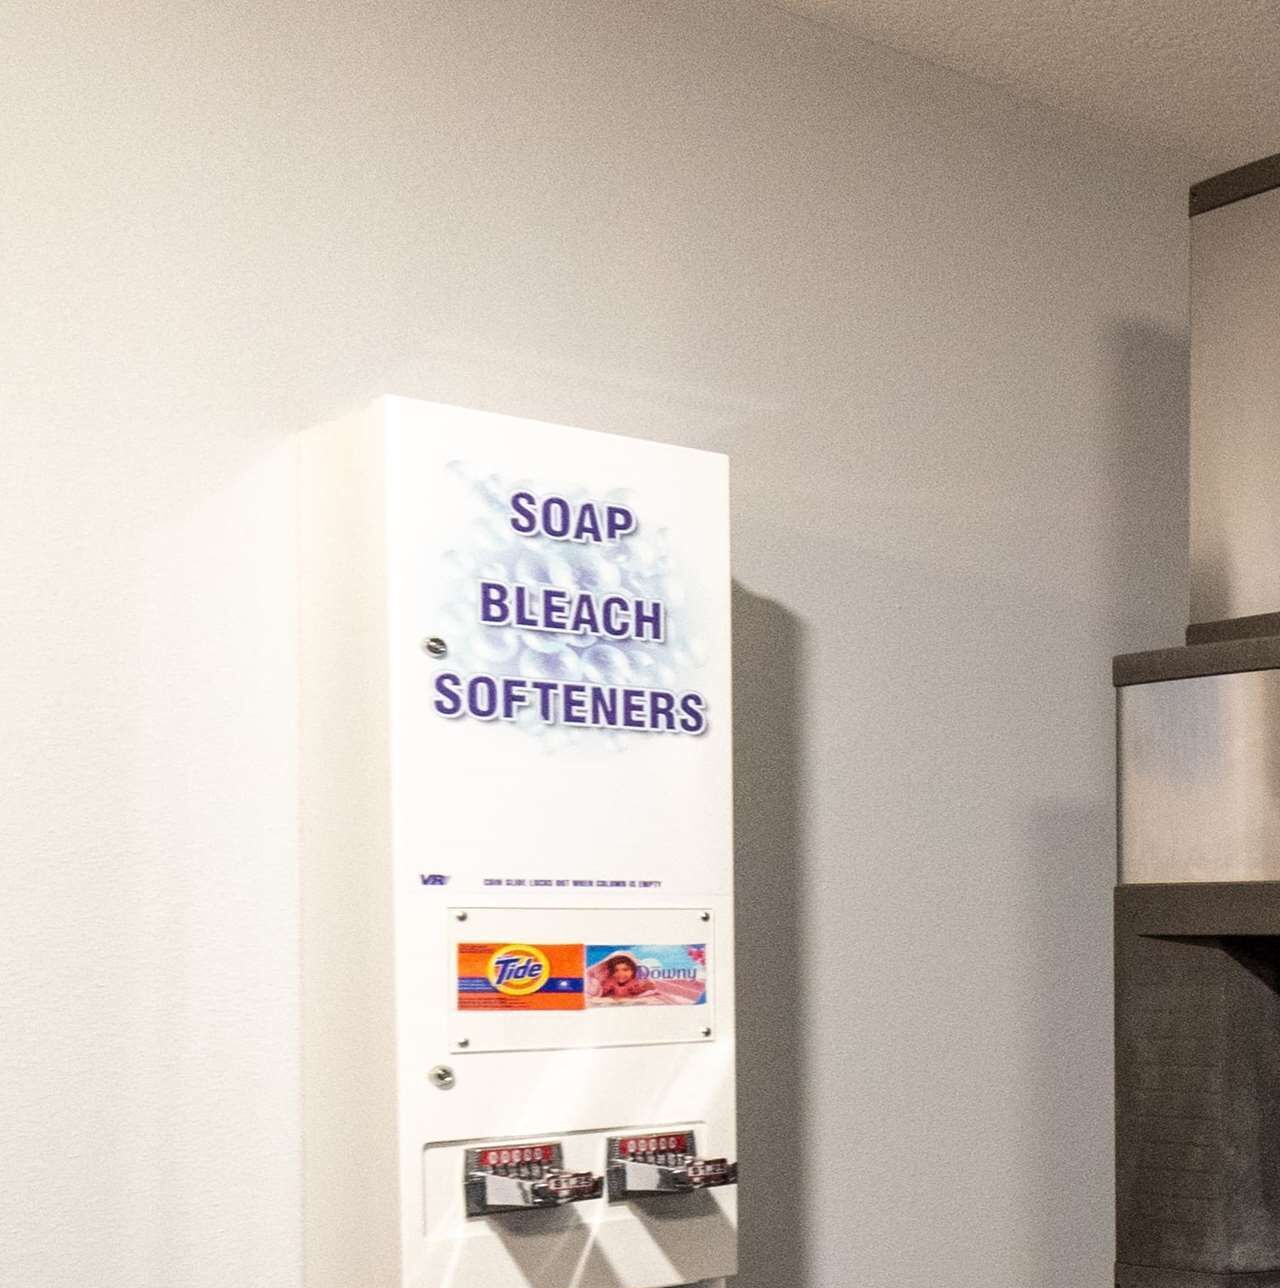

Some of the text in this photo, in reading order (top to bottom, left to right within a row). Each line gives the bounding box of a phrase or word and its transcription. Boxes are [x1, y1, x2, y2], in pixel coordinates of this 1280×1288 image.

[510, 492, 633, 543] SOAP
[480, 581, 662, 640] BLEACH
[434, 672, 704, 733] SOFTENERS
[494, 957, 544, 985] Tide
[635, 964, 697, 980] Downy
